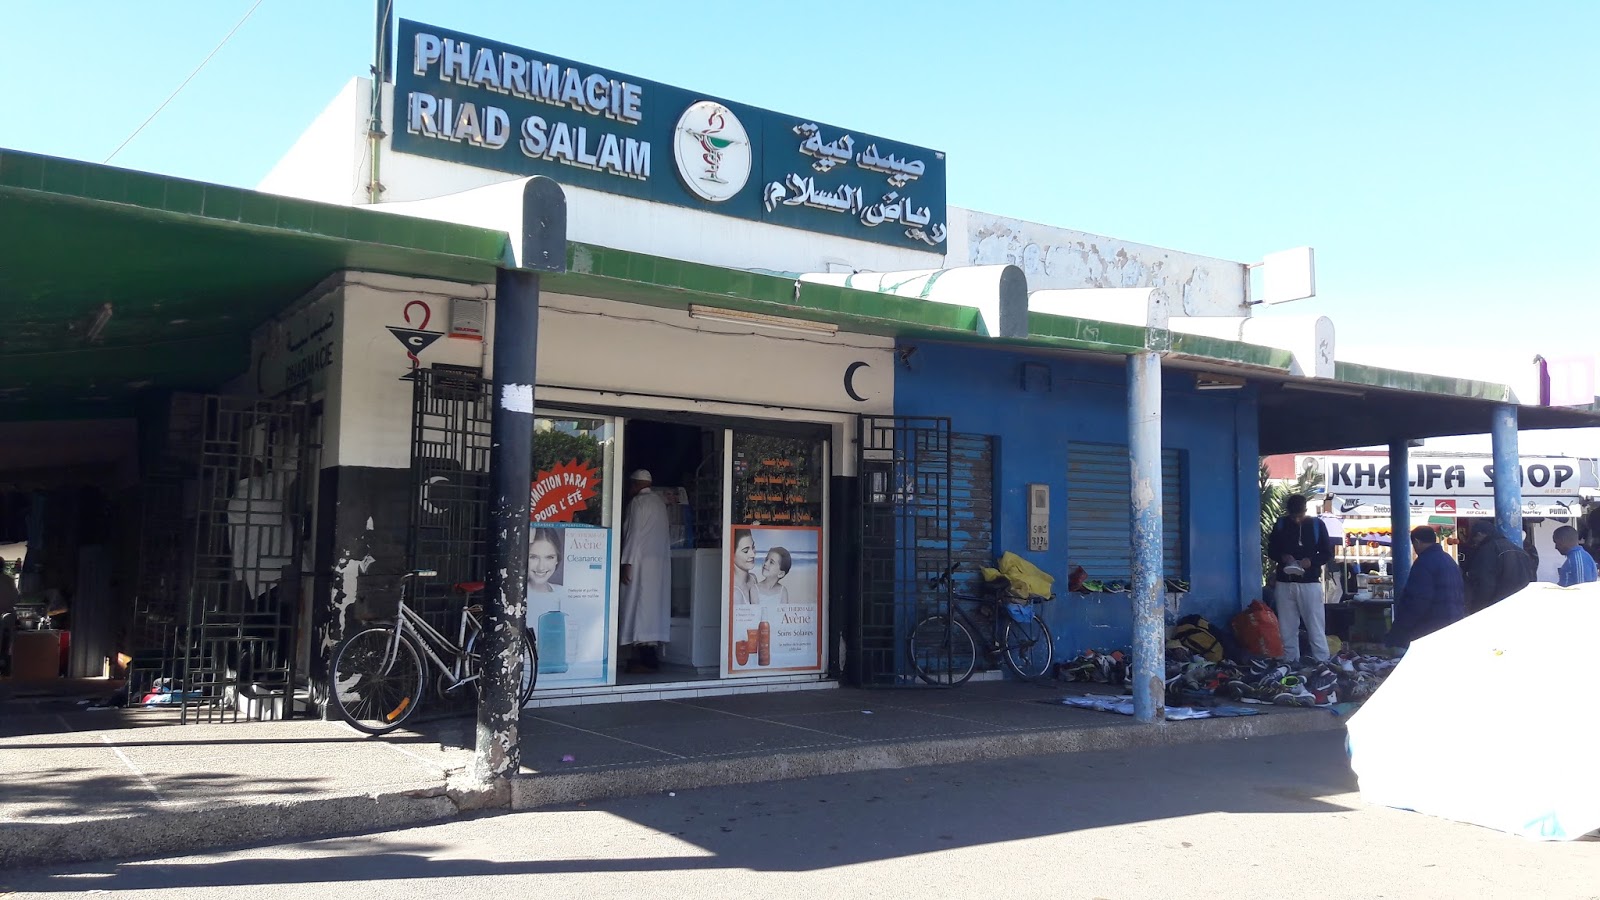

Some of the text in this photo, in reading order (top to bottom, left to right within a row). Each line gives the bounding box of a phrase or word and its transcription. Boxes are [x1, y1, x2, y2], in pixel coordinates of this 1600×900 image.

[413, 32, 642, 125] PHARMACIE
[407, 91, 650, 181] RIAD SALAM
[763, 172, 946, 246] رياض السلام
[563, 472, 588, 489] PARA
[1331, 462, 1574, 490] KHAIFA SOP
[534, 503, 559, 523] POUR
[566, 488, 583, 506] ÉTÉ
[1344, 498, 1360, 506] NIKE
[570, 538, 602, 550] Avène
[567, 554, 603, 563] Cleanance
[781, 612, 811, 624] Avène
[777, 629, 792, 637] Soins
